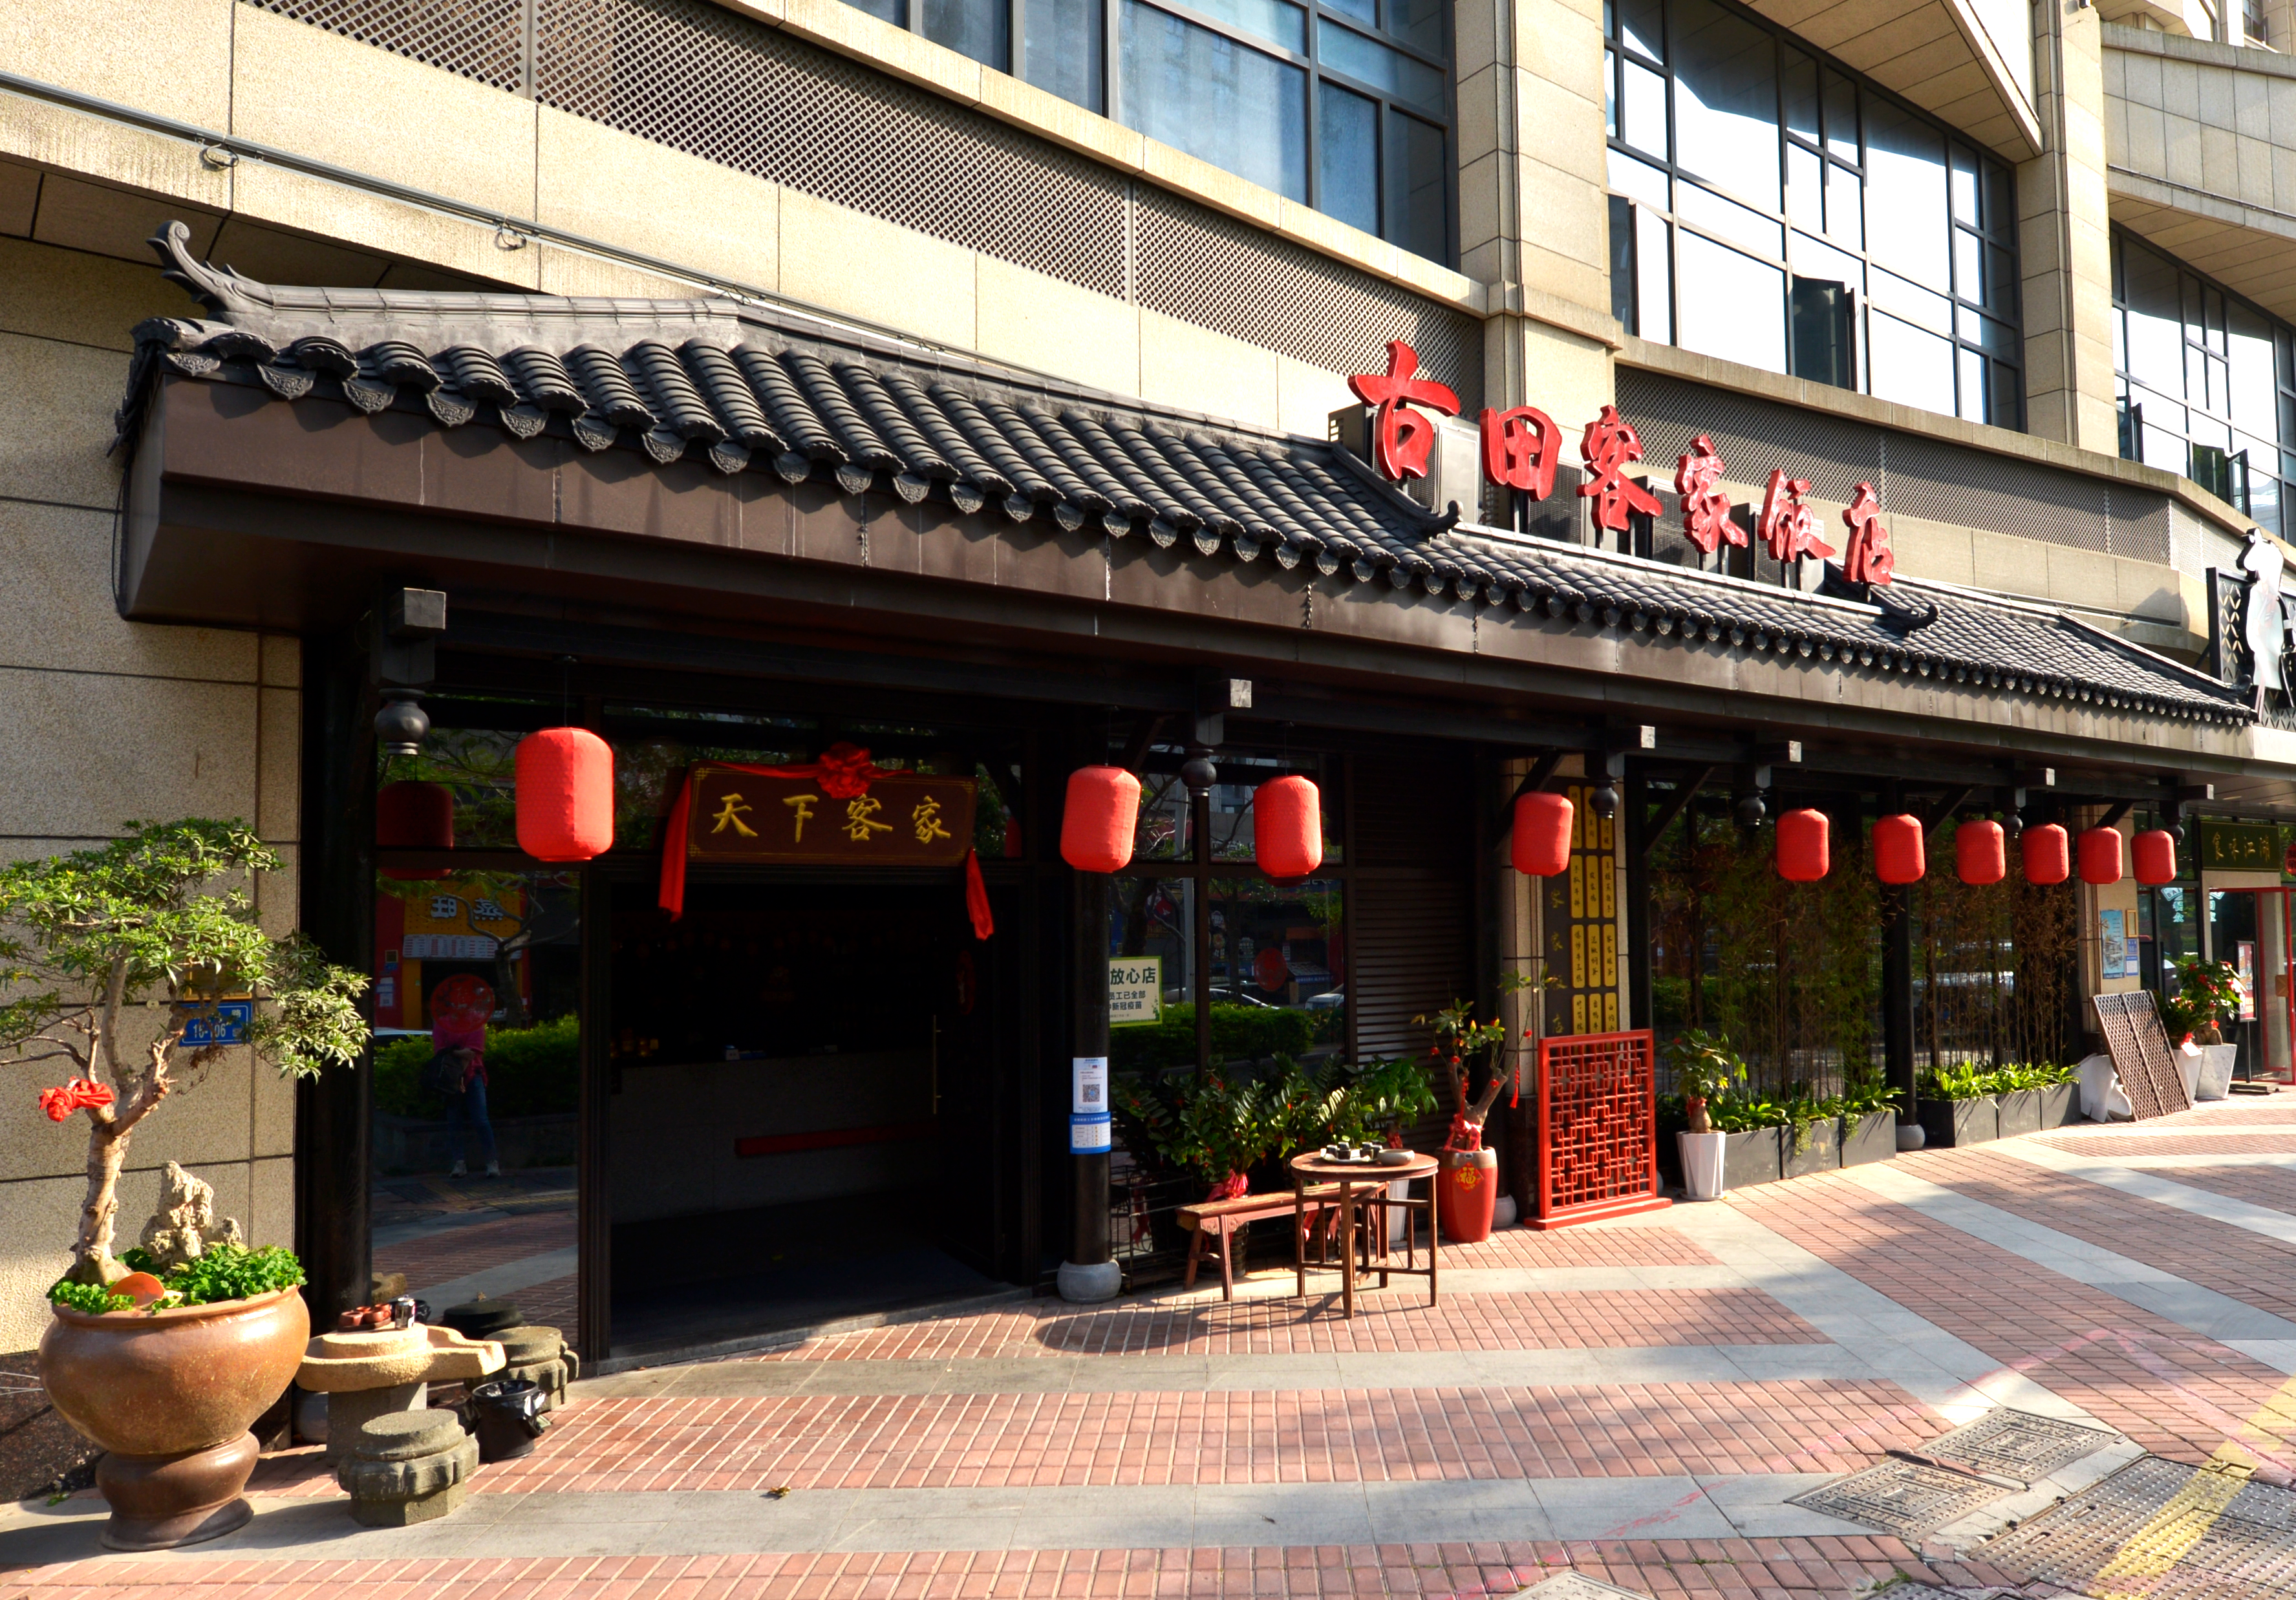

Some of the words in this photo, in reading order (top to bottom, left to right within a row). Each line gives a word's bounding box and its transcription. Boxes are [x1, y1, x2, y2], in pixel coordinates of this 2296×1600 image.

[1347, 339, 1894, 586] 古田客家饭店
[710, 793, 952, 844] 天下客家
[1110, 966, 1156, 985] 放心店
[1459, 1166, 1477, 1184] 福
